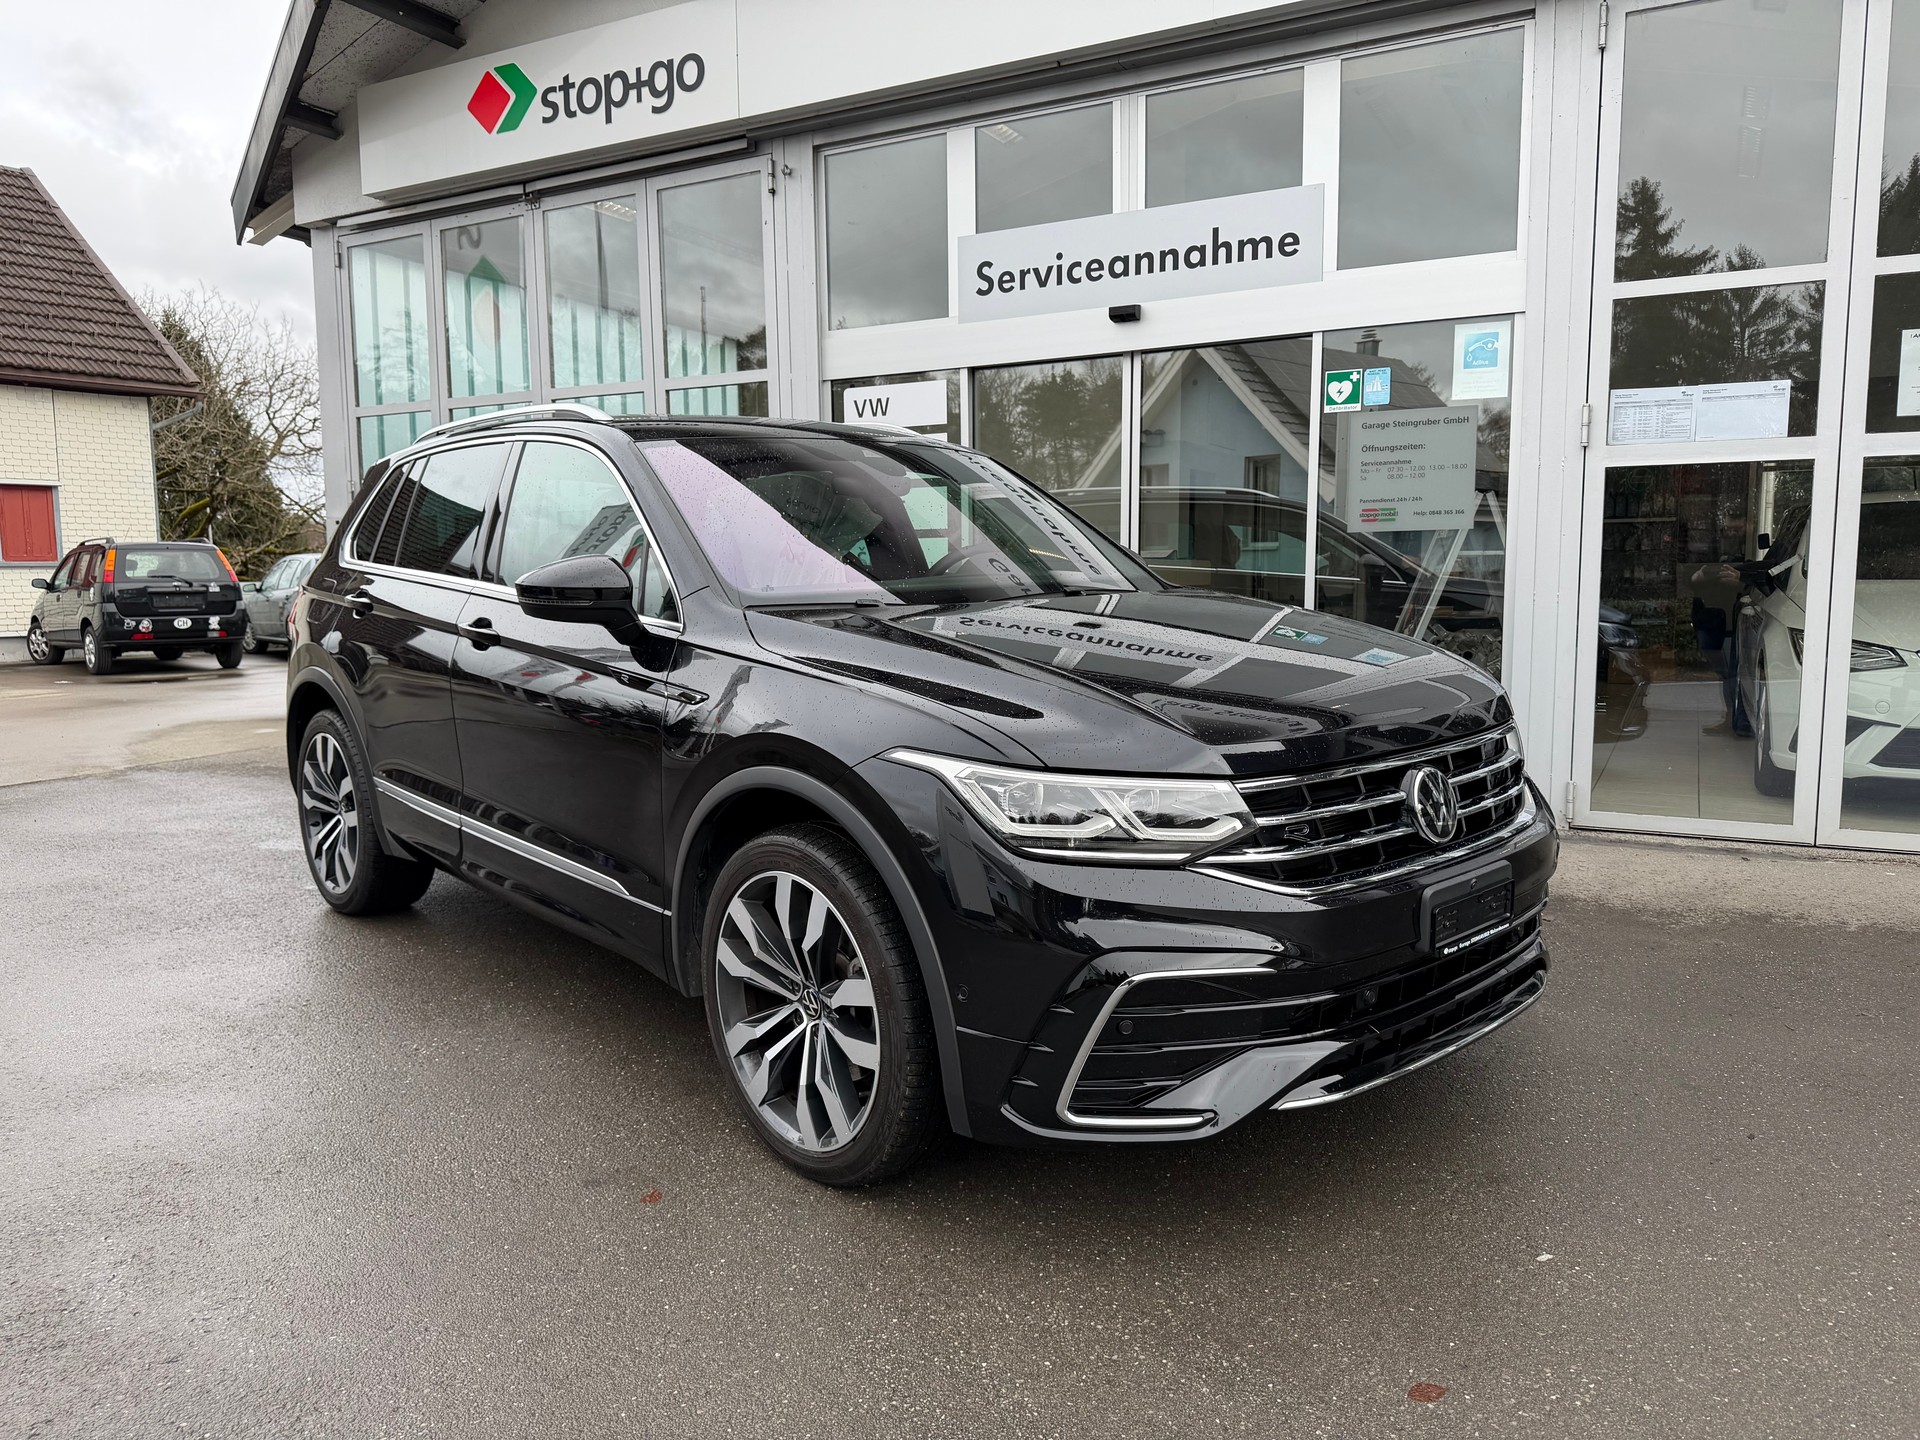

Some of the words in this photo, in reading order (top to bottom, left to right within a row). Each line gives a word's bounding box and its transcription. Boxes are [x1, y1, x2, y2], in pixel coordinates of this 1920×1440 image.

[541, 53, 705, 124] stop+go
[975, 226, 1300, 296] Serviceannahme
[853, 397, 890, 418] VW
[1361, 422, 1391, 430] Garage
[1392, 418, 1441, 428] Steingruber
[1443, 416, 1470, 425] GmbH
[1361, 442, 1426, 453] Öffnungszeiten:
[1360, 459, 1412, 467] Serviceannahme
[177, 619, 188, 627] CH
